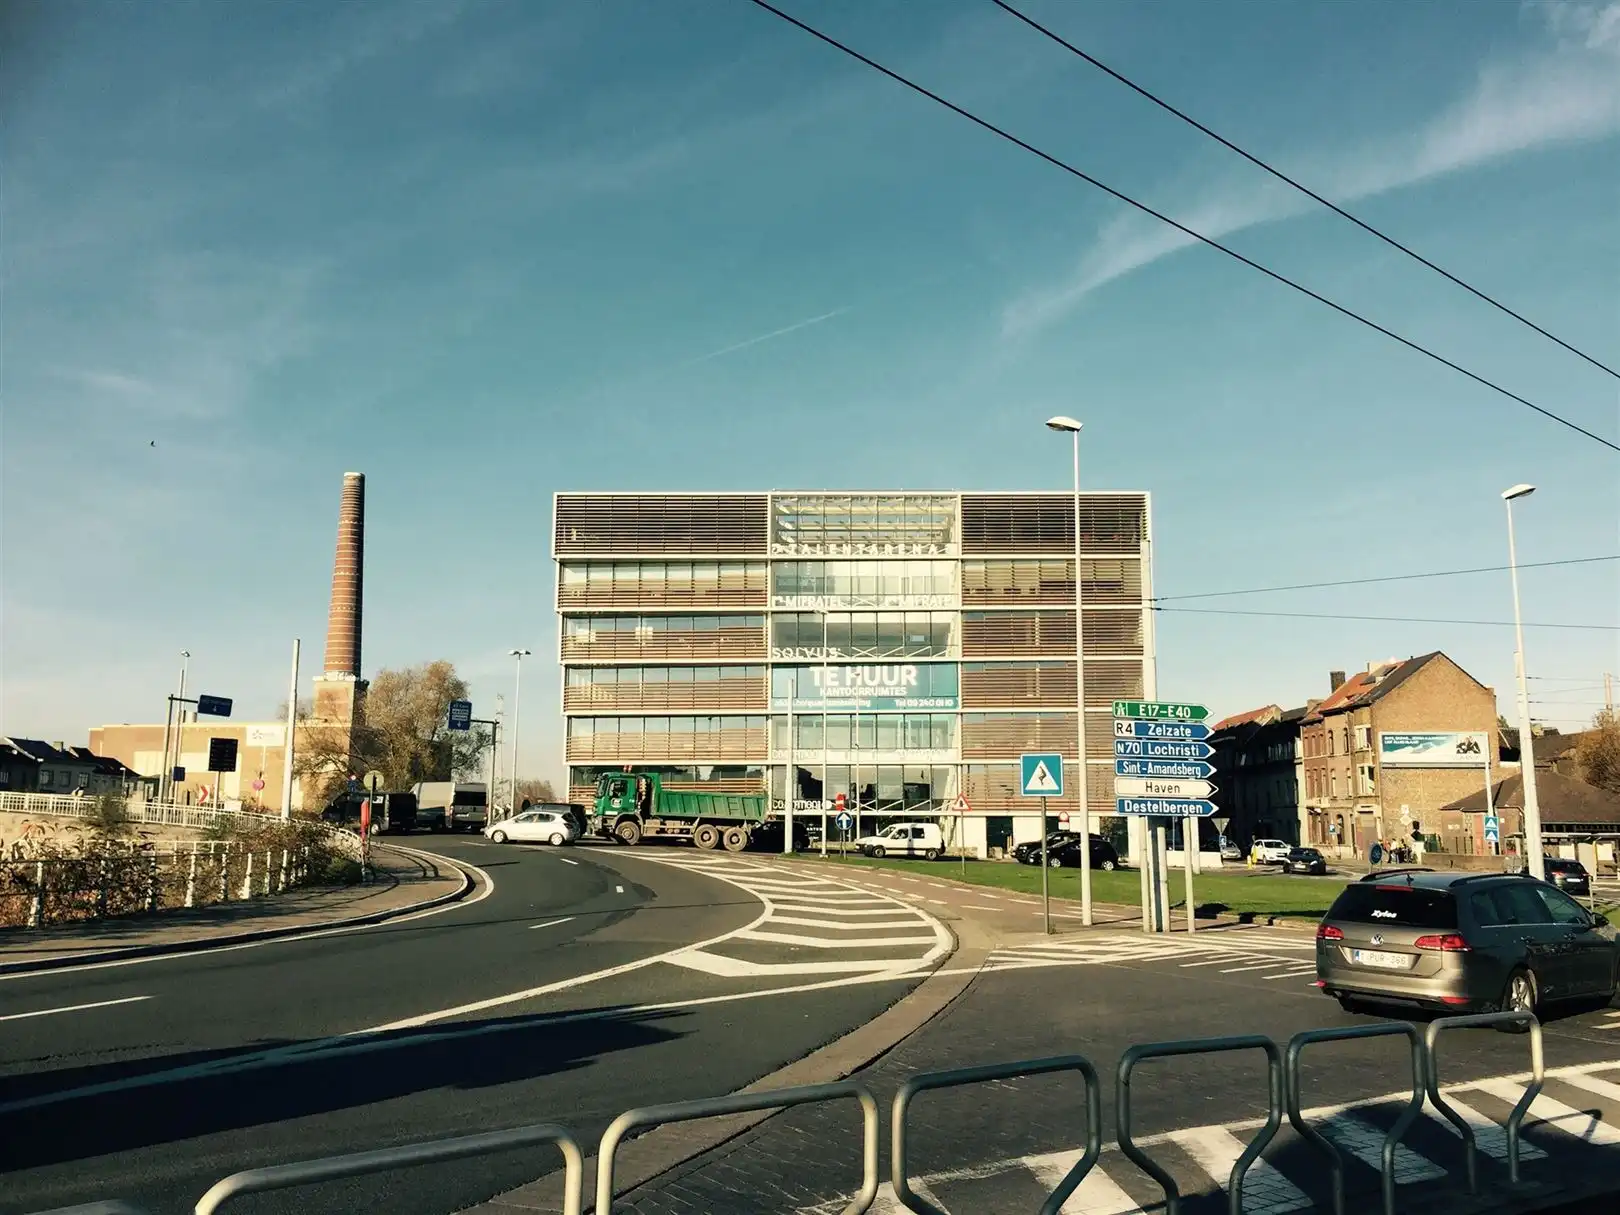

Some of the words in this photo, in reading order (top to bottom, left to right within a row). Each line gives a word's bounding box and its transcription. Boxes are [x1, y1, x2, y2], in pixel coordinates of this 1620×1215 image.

[809, 666, 839, 687] TE
[845, 665, 918, 687] HUUR
[820, 687, 908, 697] KANTOORRUIMTES
[1139, 704, 1191, 717] E17-E40
[1148, 724, 1192, 736] Zelzate
[1117, 742, 1140, 754] N70
[1148, 743, 1200, 756] Lochristi
[1123, 761, 1201, 778] Sint-Amandsberg
[1145, 782, 1181, 793] Haven
[1124, 800, 1203, 815] Destelbergen
